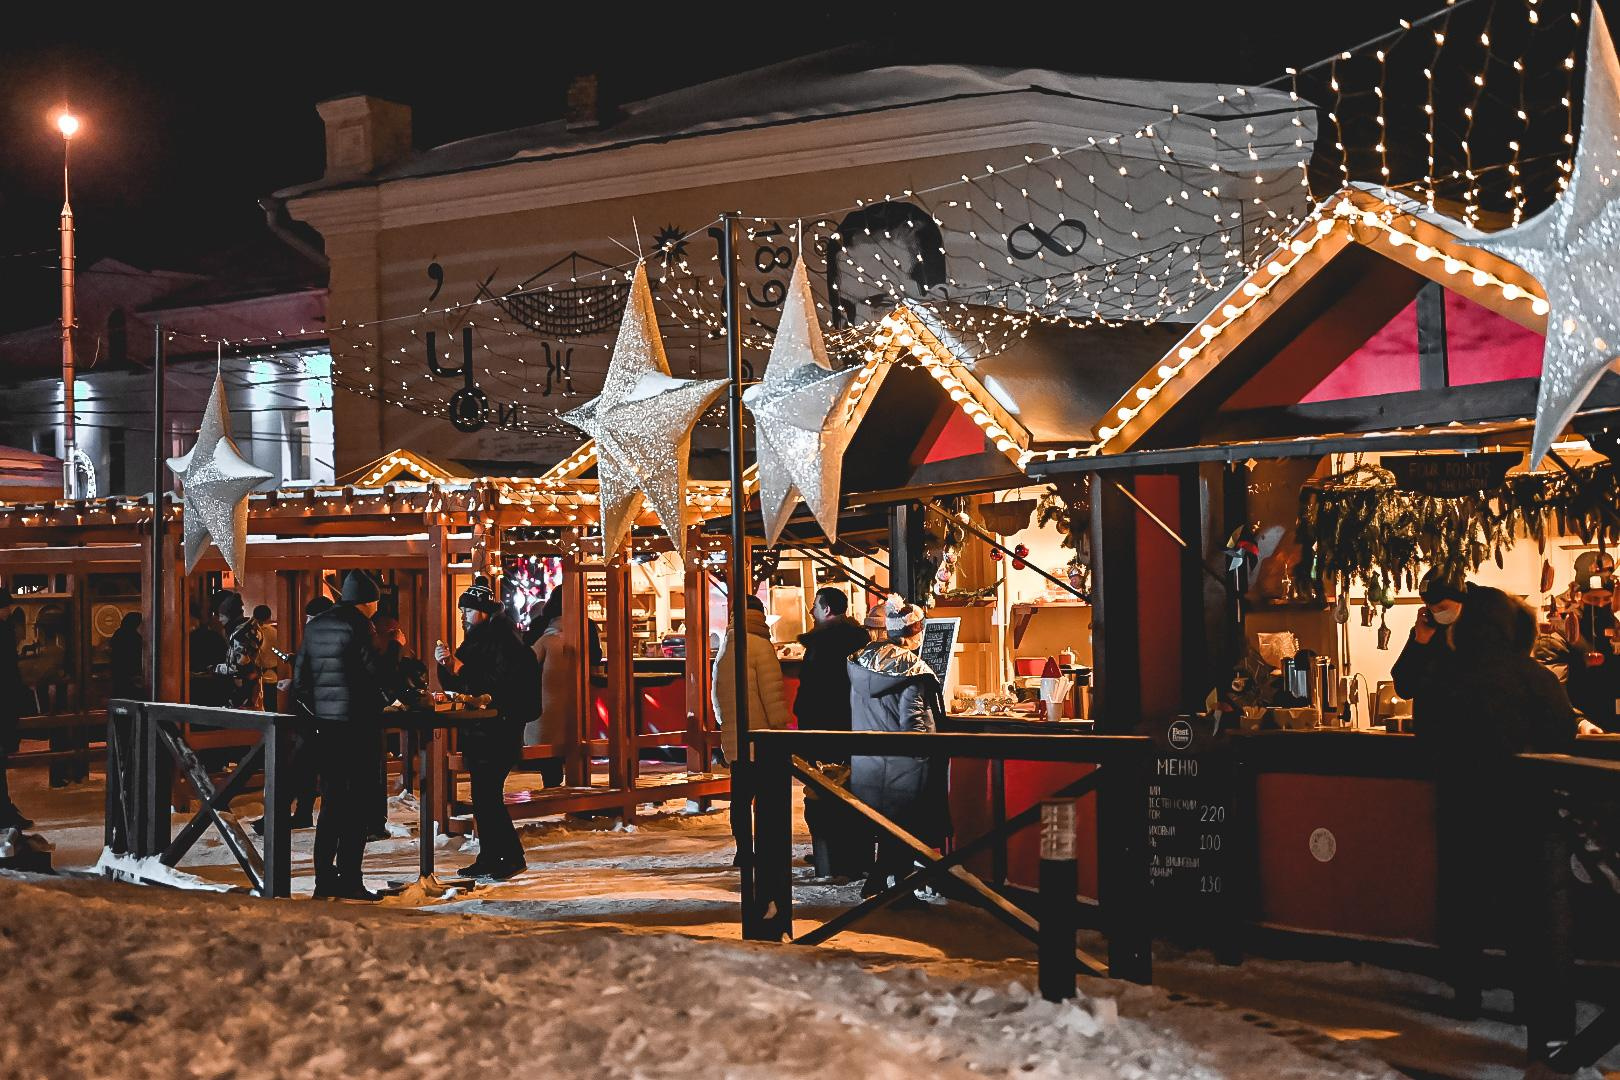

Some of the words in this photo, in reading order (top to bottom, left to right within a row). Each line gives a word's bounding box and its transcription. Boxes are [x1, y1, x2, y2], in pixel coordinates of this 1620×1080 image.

[1157, 758, 1198, 776] МЕНЮ
[1200, 805, 1225, 823] 220
[1199, 834, 1221, 851] 100
